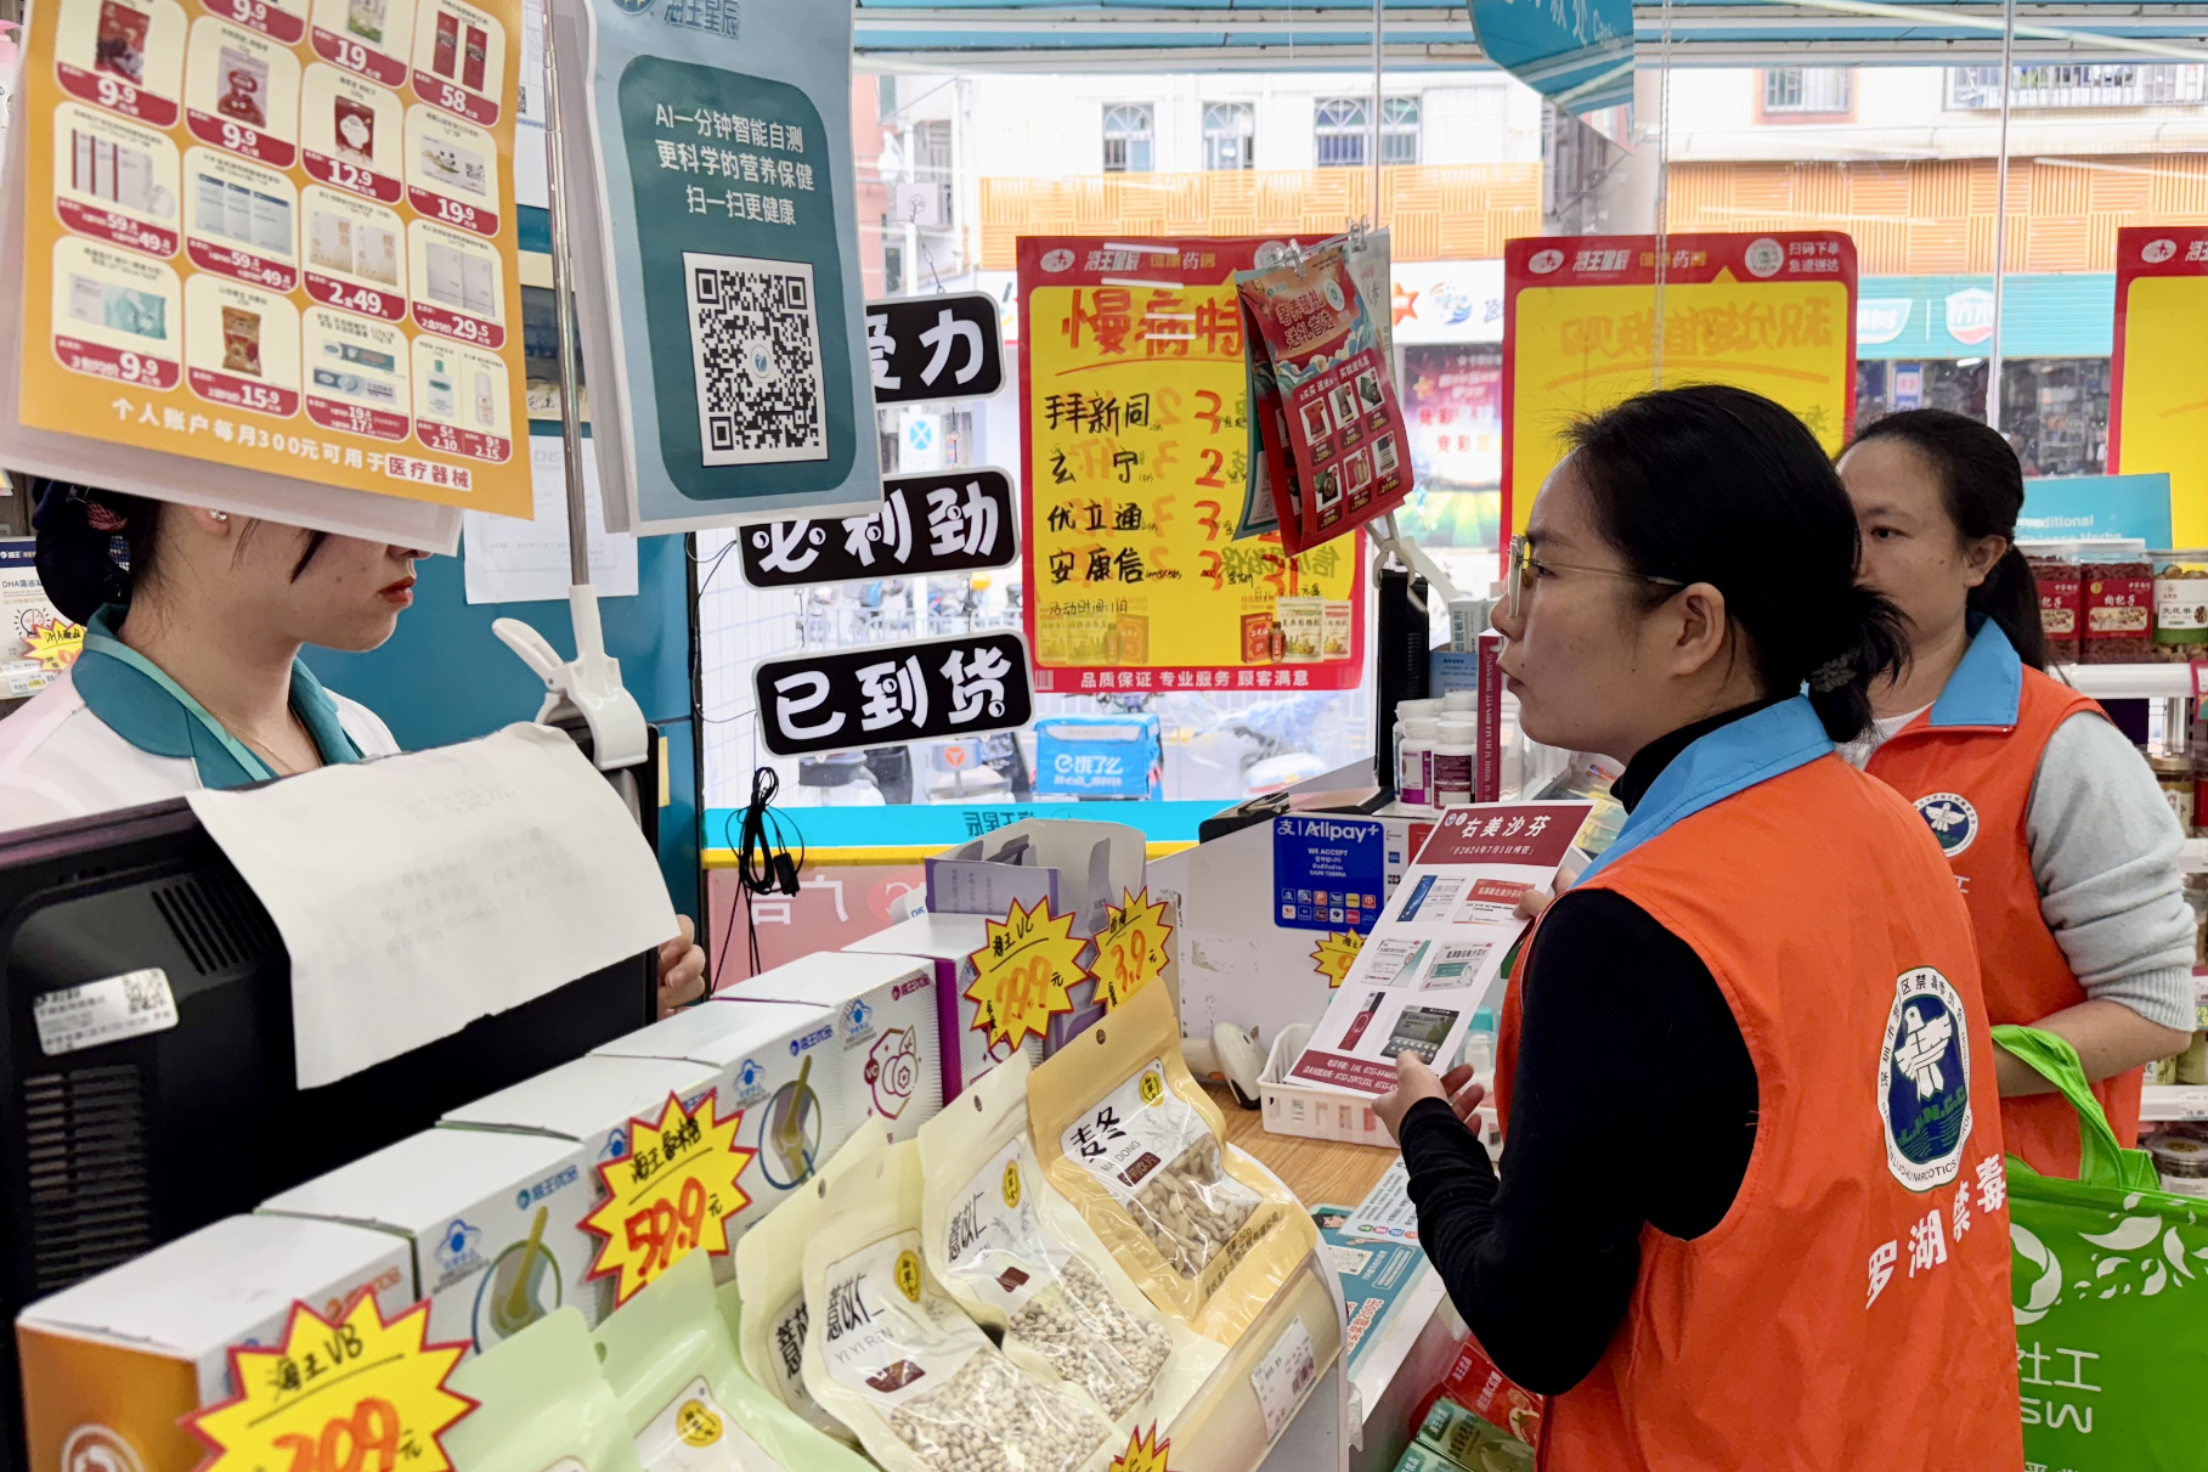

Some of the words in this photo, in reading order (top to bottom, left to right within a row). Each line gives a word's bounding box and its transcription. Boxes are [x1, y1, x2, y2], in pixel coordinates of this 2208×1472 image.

[335, 39, 366, 71] 19
[97, 77, 137, 106] 9.9
[440, 84, 466, 113] 58
[222, 123, 257, 150] 9.9
[655, 103, 804, 154] AI一分钟智能自测
[328, 160, 373, 191] 12.9
[654, 139, 816, 192] 更科学的营养保健
[437, 198, 475, 223] 19.9
[685, 184, 797, 226] 扫一扫更健康
[452, 314, 489, 340] 29.5
[120, 352, 159, 380] 9.9
[241, 385, 280, 408] 15.9
[111, 397, 473, 492] 个人账户每月300元可用于医疗器械
[751, 480, 1001, 574] 必利劲
[1048, 546, 1145, 587] 安康信
[773, 645, 1013, 741] 已到货
[1080, 669, 1153, 689] 品质保证
[1158, 669, 1232, 688] 专业服务
[1236, 668, 1310, 688] 顾客满意
[1304, 820, 1380, 844] Alipay+
[1461, 814, 1552, 839] 右美沙芬
[1307, 847, 1319, 855] WE
[1320, 848, 1349, 857] ACCEPT
[1110, 928, 1147, 994] 3.9
[1113, 1139, 1142, 1163] DONG
[1864, 1152, 2008, 1312] 罗湖禁毒
[325, 1323, 364, 1366] VB
